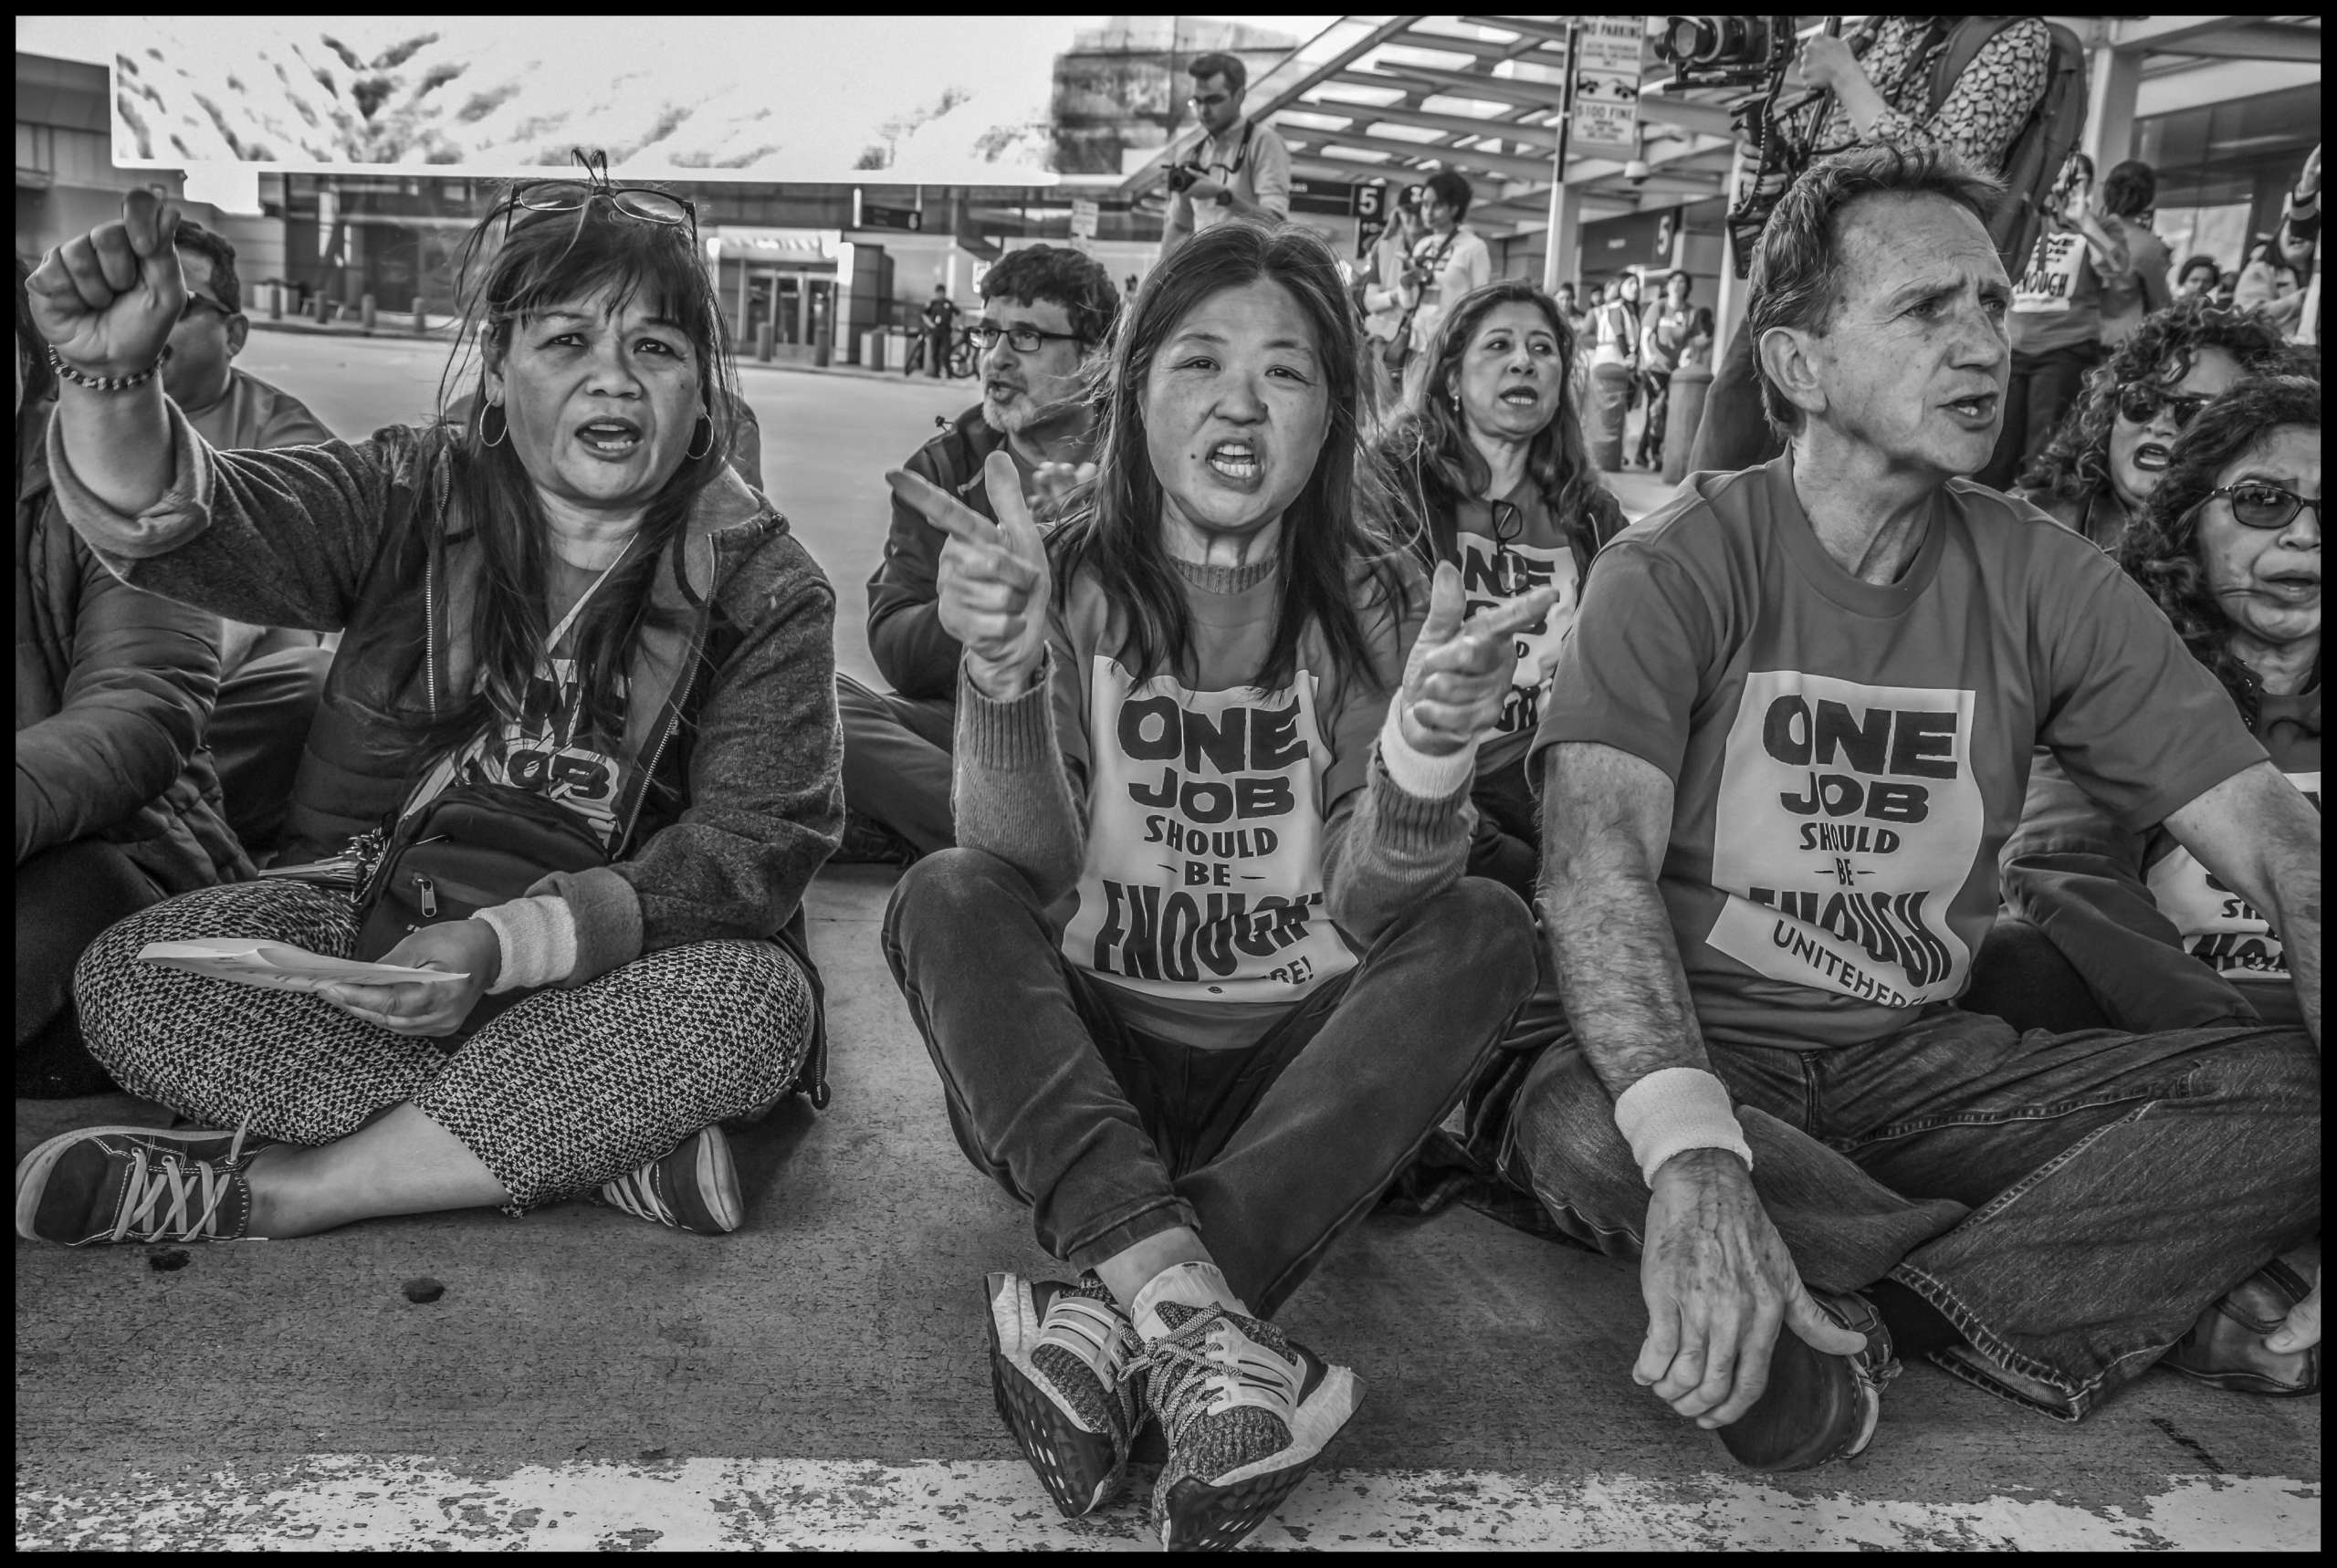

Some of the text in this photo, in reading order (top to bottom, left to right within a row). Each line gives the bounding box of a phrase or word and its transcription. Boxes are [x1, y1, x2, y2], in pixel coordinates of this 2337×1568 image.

[1600, 23, 1641, 38] PARKING
[1358, 186, 1378, 215] 5
[1657, 215, 1670, 256] 5
[2011, 271, 2069, 298] NOUGH
[1117, 695, 1309, 775] ONE
[1763, 695, 1957, 779] ONE
[1128, 767, 1295, 823] JOB
[1780, 772, 1929, 823] JOB
[1144, 815, 1278, 859] SHOULD
[1799, 822, 1900, 854] SHOULD
[1184, 861, 1231, 887] BE
[1836, 858, 1854, 886] BE
